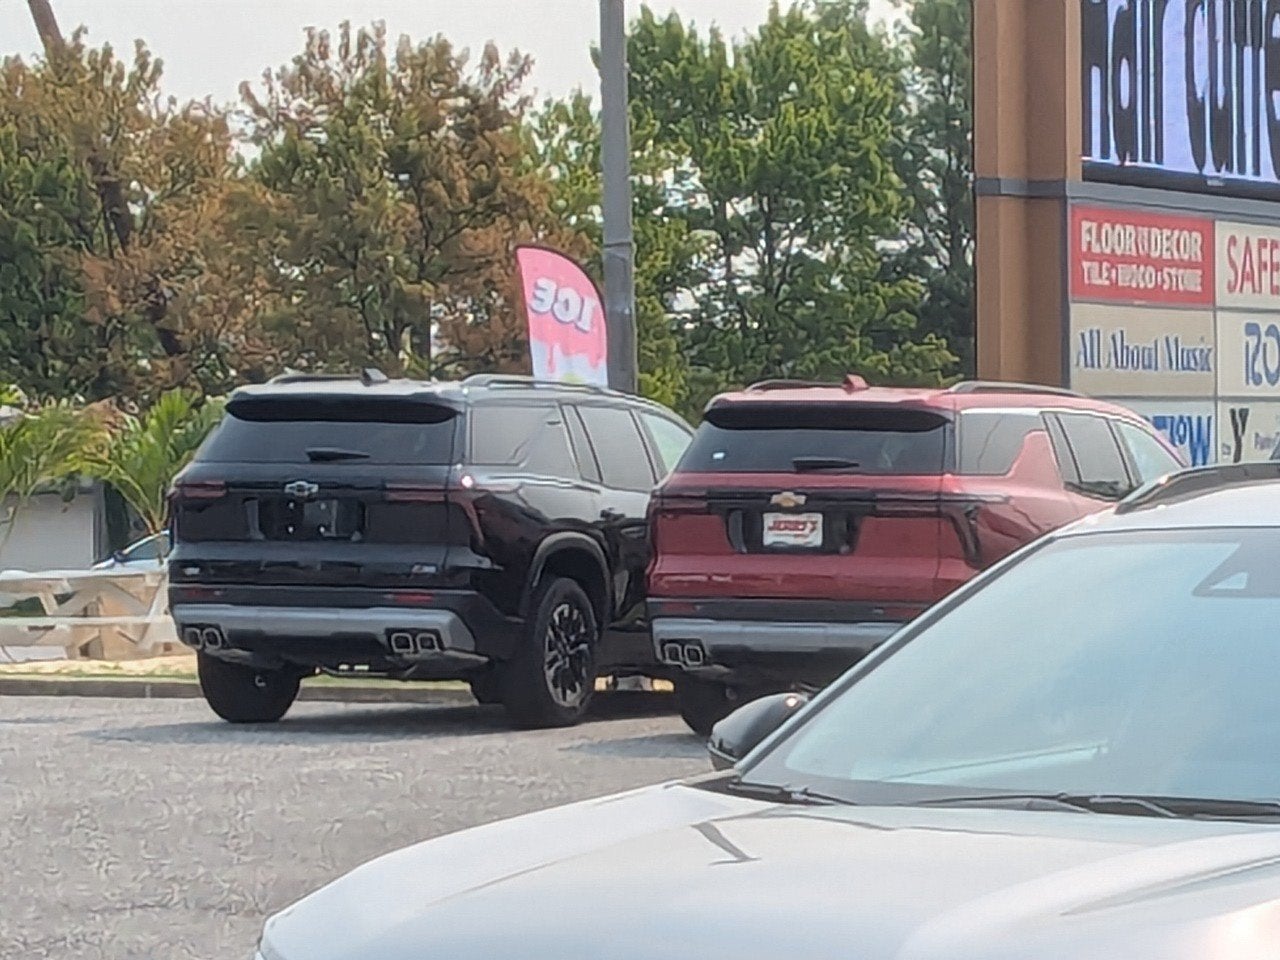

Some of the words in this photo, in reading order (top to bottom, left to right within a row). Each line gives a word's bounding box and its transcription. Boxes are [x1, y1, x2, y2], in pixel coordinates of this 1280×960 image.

[1081, 220, 1137, 257] FLOOR
[1150, 227, 1203, 262] DECOR
[1076, 328, 1101, 370] All
[1106, 329, 1158, 371] About
[1164, 336, 1213, 373] Music
